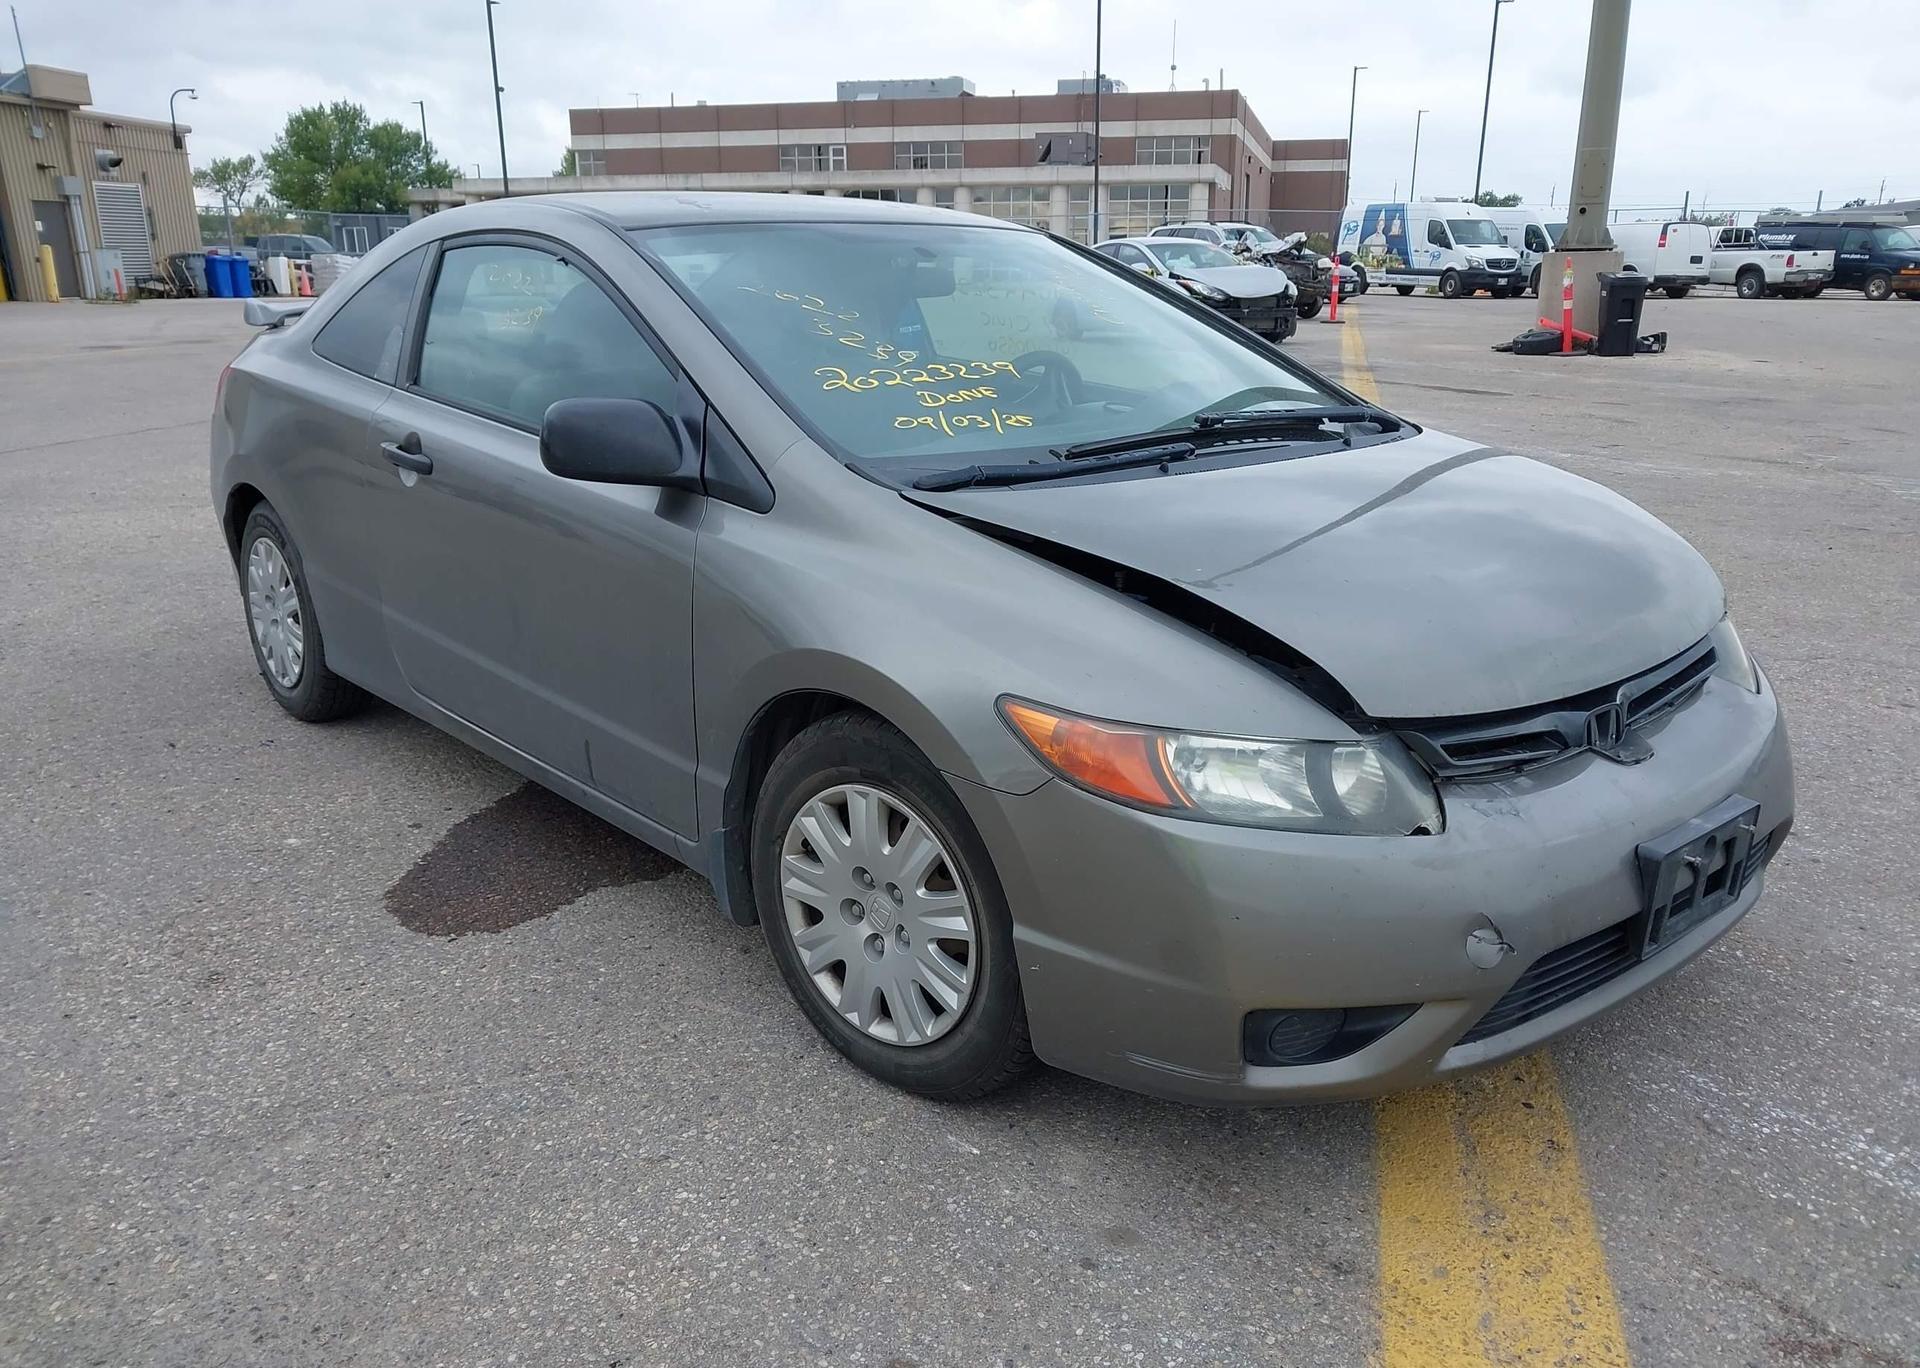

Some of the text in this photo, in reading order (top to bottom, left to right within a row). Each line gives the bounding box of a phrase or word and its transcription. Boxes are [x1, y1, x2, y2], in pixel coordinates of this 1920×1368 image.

[815, 361, 1022, 393] 20223239
[916, 386, 998, 407] DONE
[894, 408, 1033, 437] 09/03/25
